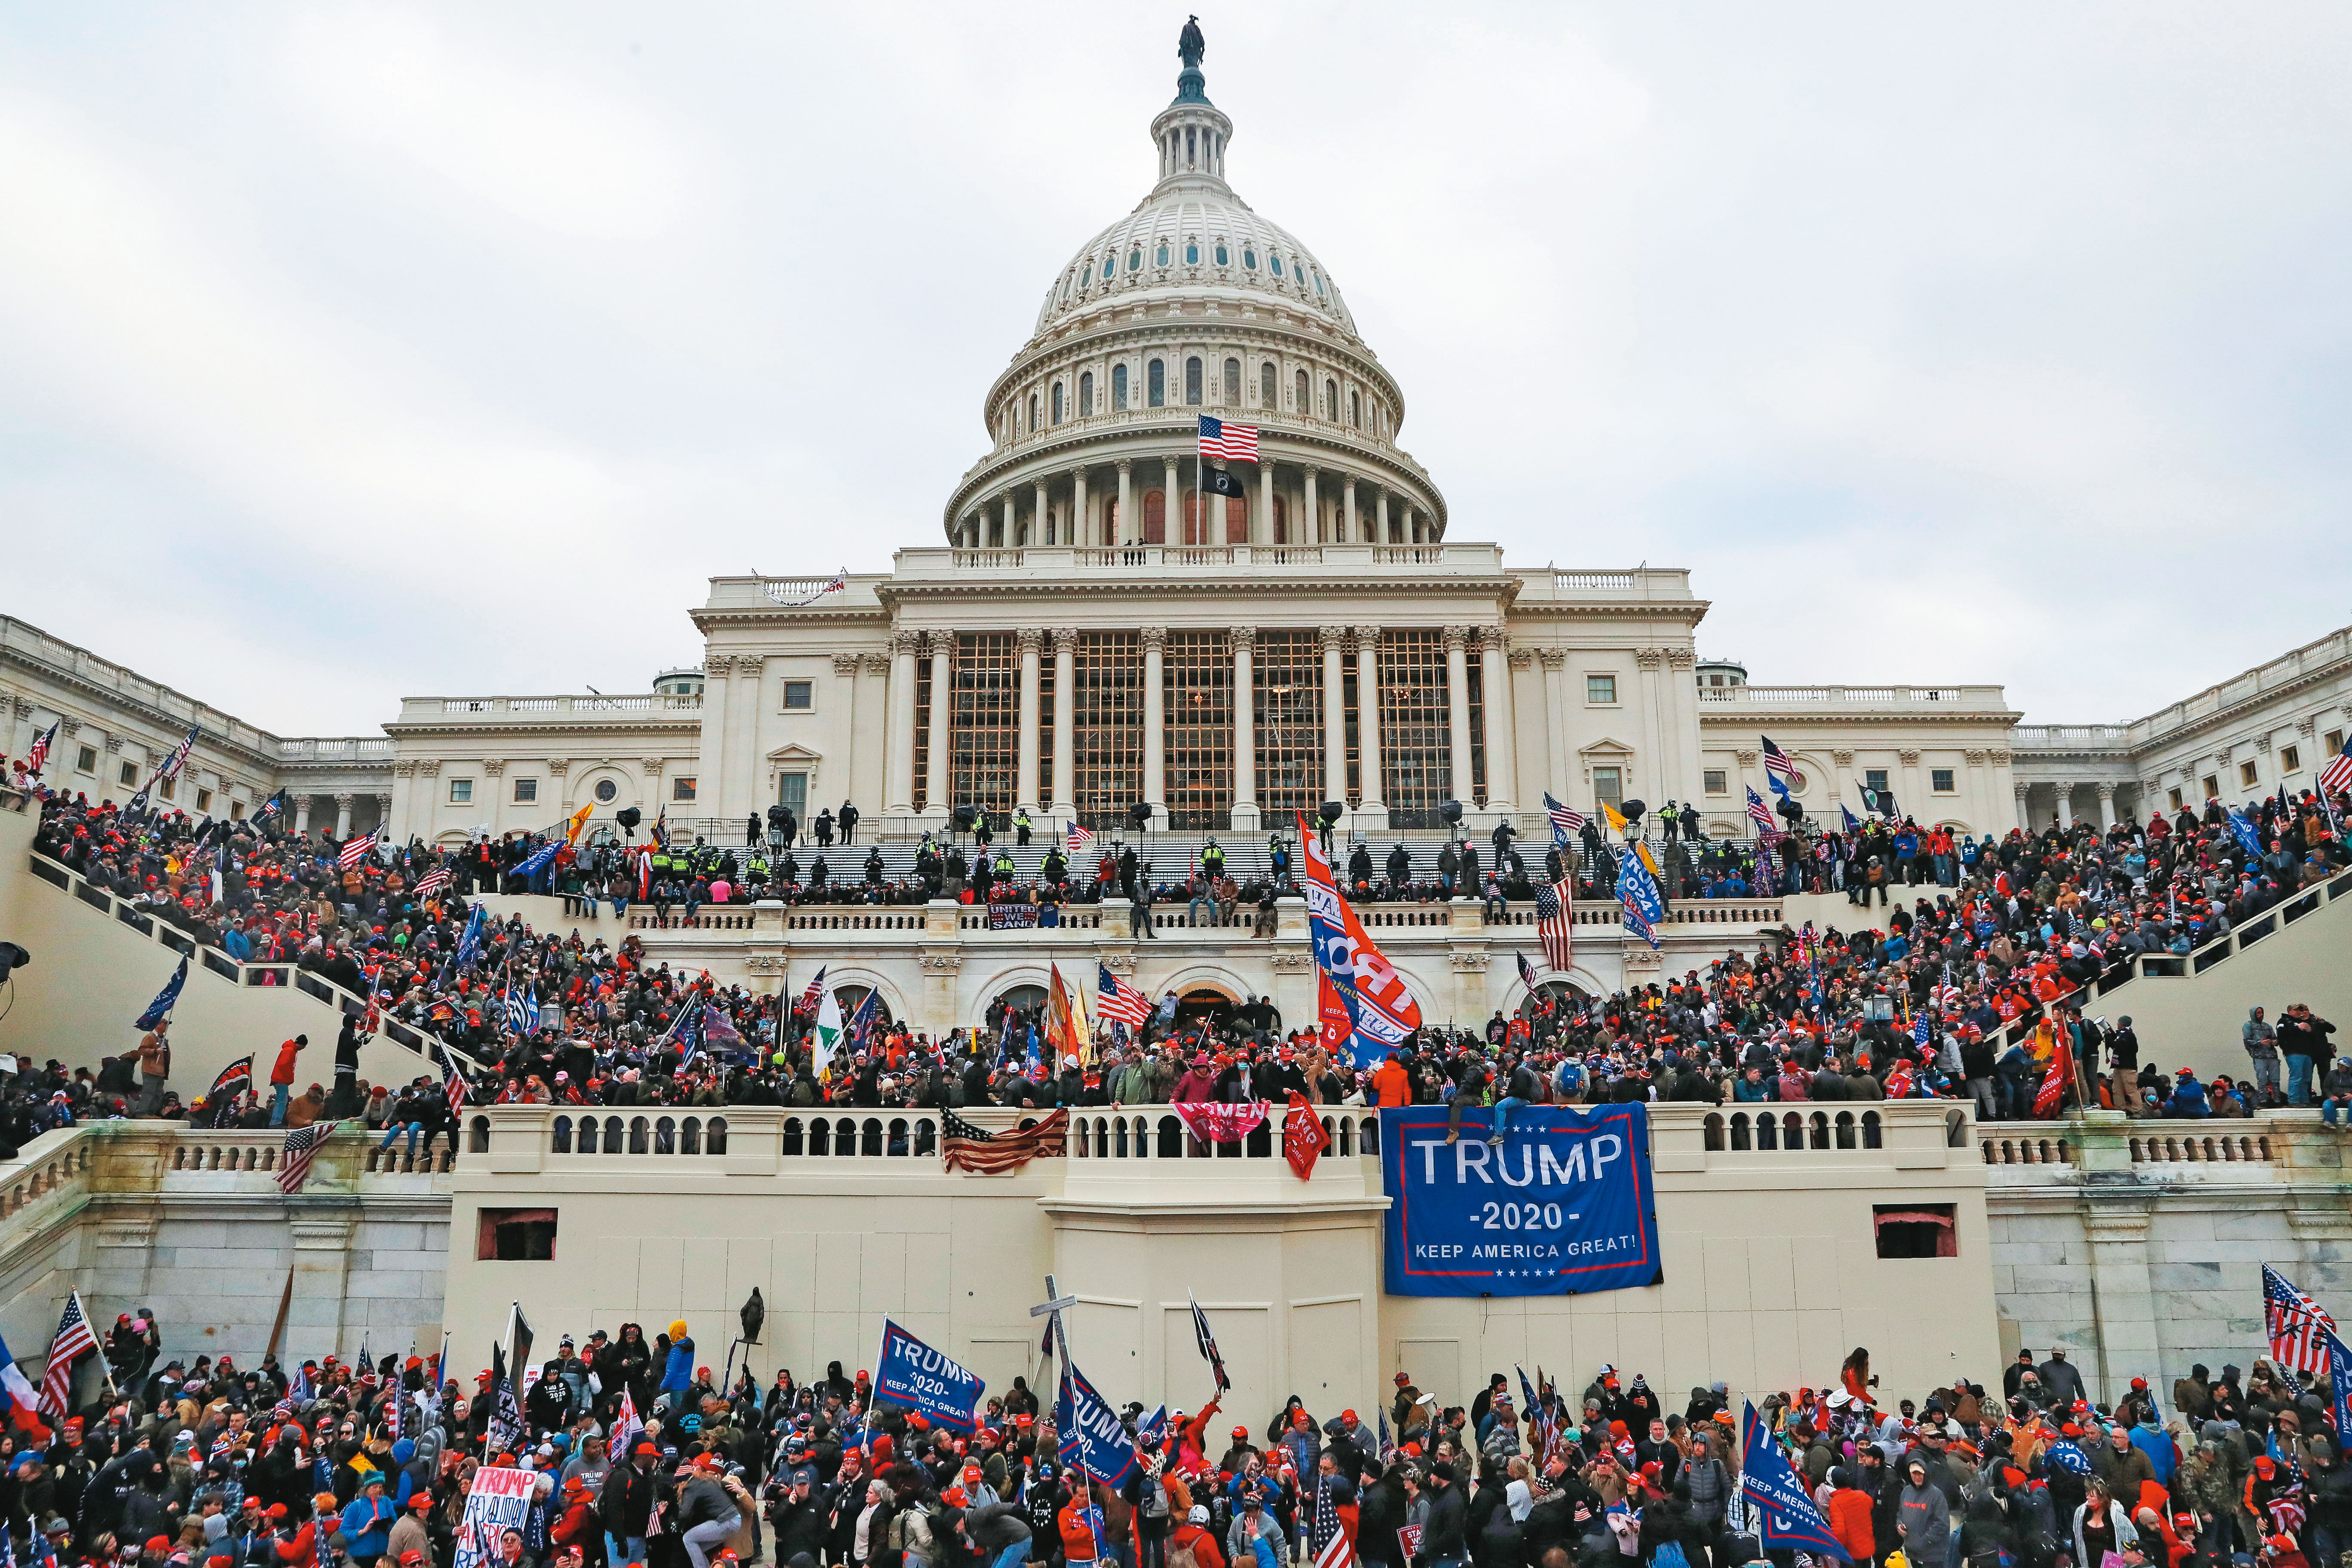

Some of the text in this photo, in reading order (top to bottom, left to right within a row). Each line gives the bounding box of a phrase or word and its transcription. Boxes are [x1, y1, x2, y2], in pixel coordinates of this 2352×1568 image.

[528, 842, 559, 870] TRUMP
[1181, 1102, 1266, 1120] WOMEN
[1412, 1134, 1622, 1187] TRUMP
[1470, 1202, 1579, 1230] -2020-
[1416, 1235, 1636, 1259] KEEP AMERICA GREAT!
[893, 1335, 973, 1384] TRUMP
[887, 1379, 907, 1390] KEEP
[476, 1468, 536, 1497] TRUMP
[1744, 1473, 1821, 1518] KEEP AMERICA
[1407, 1529, 1421, 1538] STA
